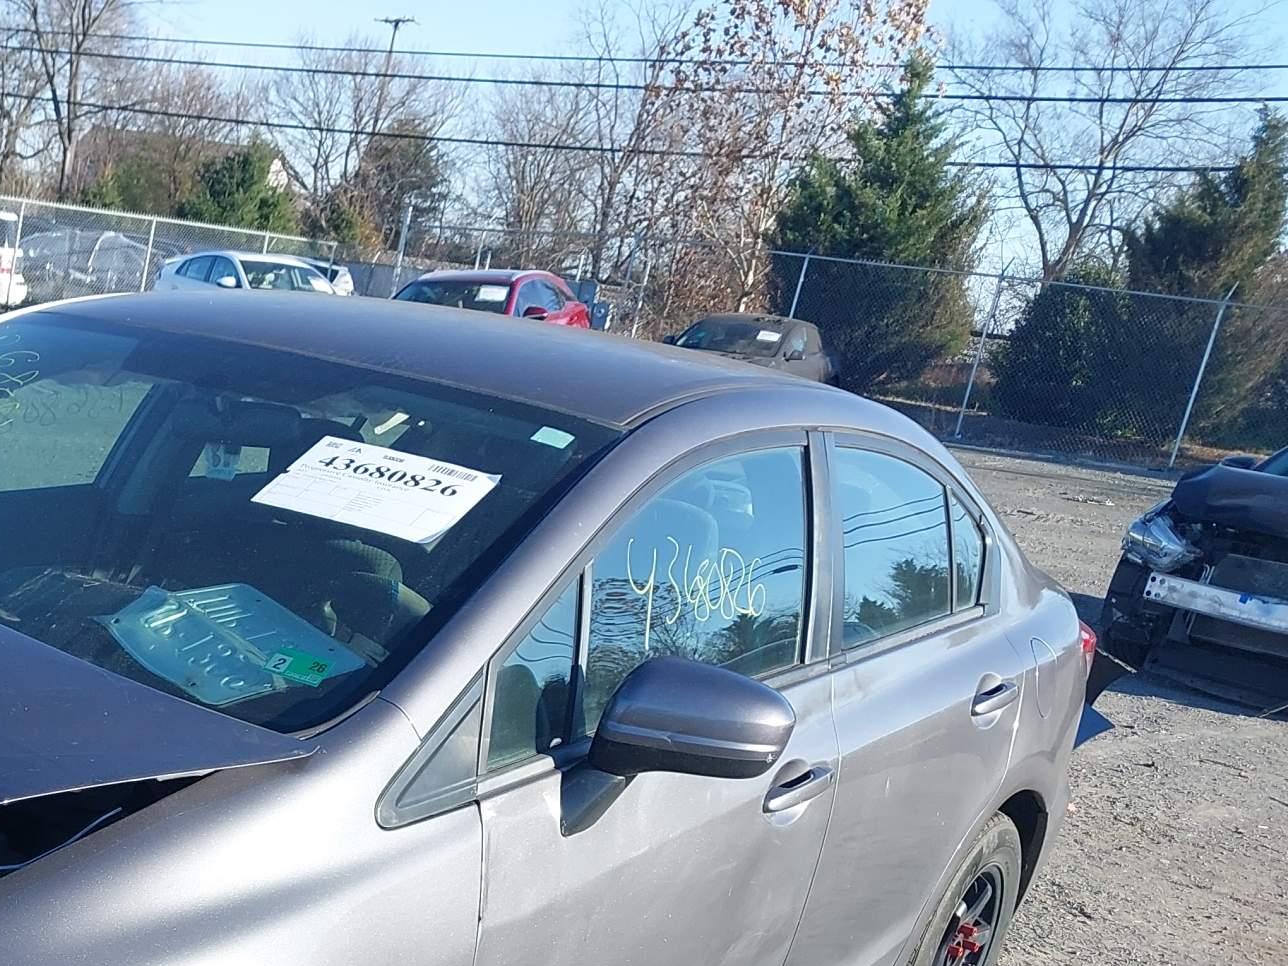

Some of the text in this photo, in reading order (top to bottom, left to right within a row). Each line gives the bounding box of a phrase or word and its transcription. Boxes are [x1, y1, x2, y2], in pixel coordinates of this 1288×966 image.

[317, 454, 458, 498] 43680826
[627, 536, 766, 651] 43680826
[272, 657, 287, 670] 2
